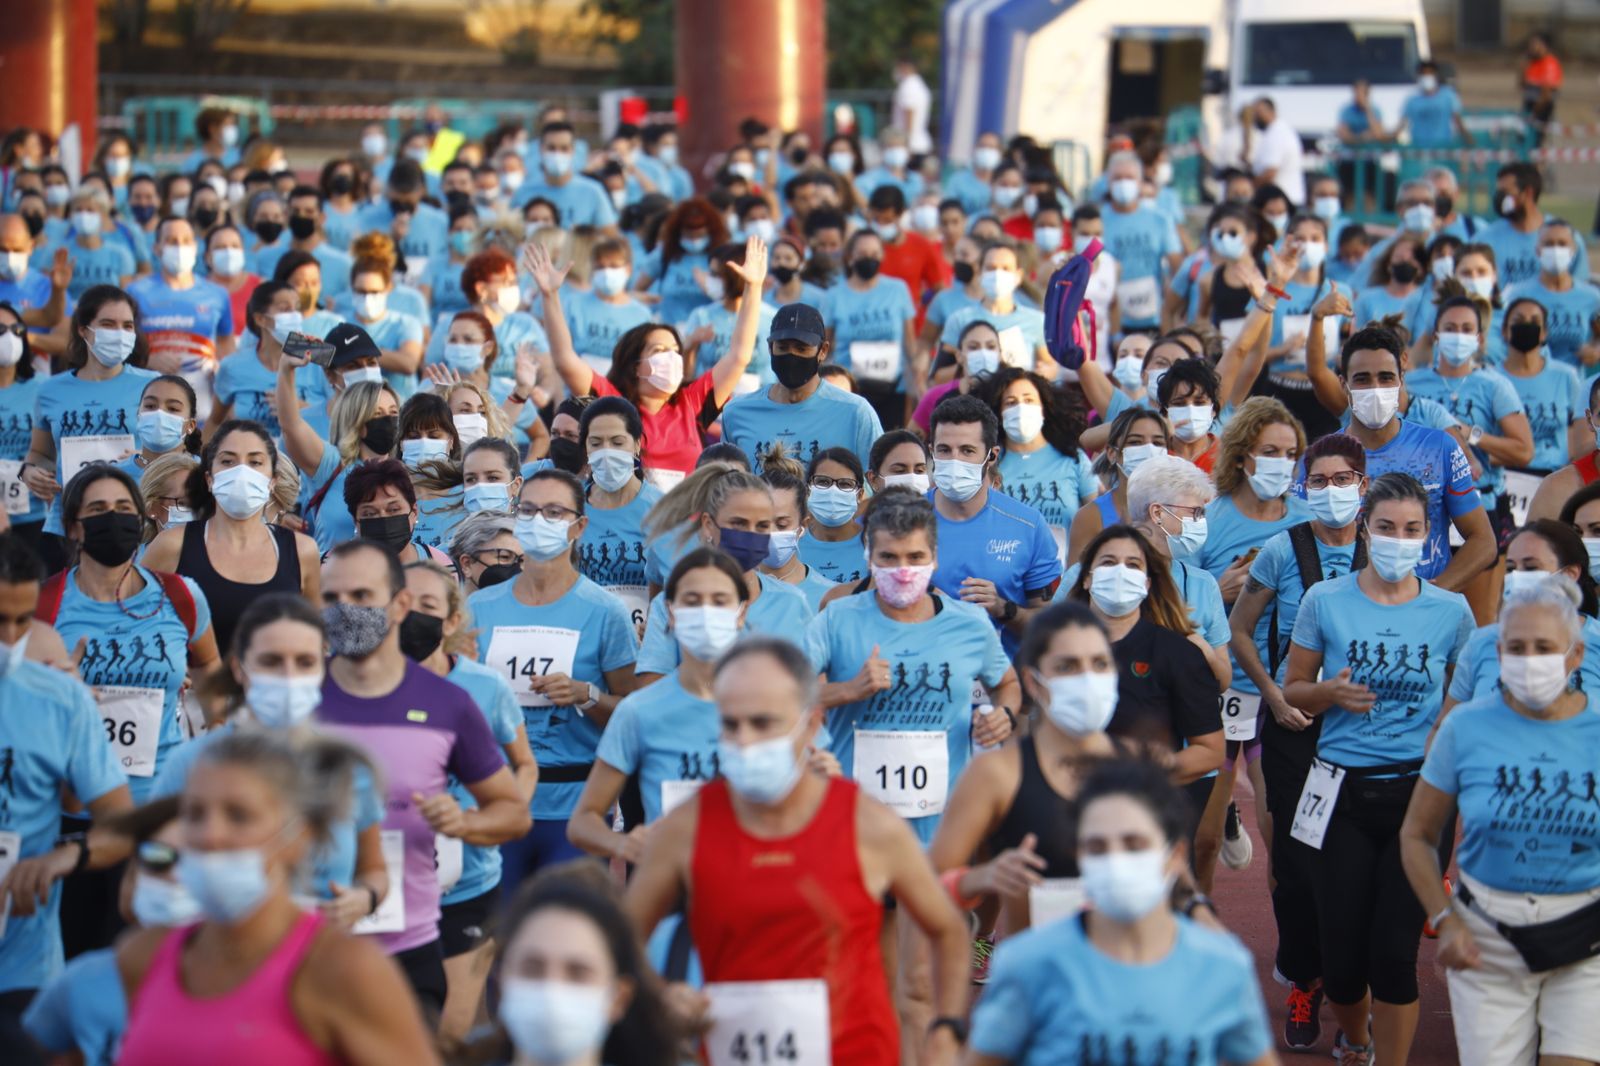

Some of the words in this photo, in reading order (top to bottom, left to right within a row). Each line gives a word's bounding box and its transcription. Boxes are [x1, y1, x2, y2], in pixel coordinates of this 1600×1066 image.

[506, 656, 554, 680] 147
[876, 764, 928, 790] 110
[728, 1029, 799, 1066] 414
